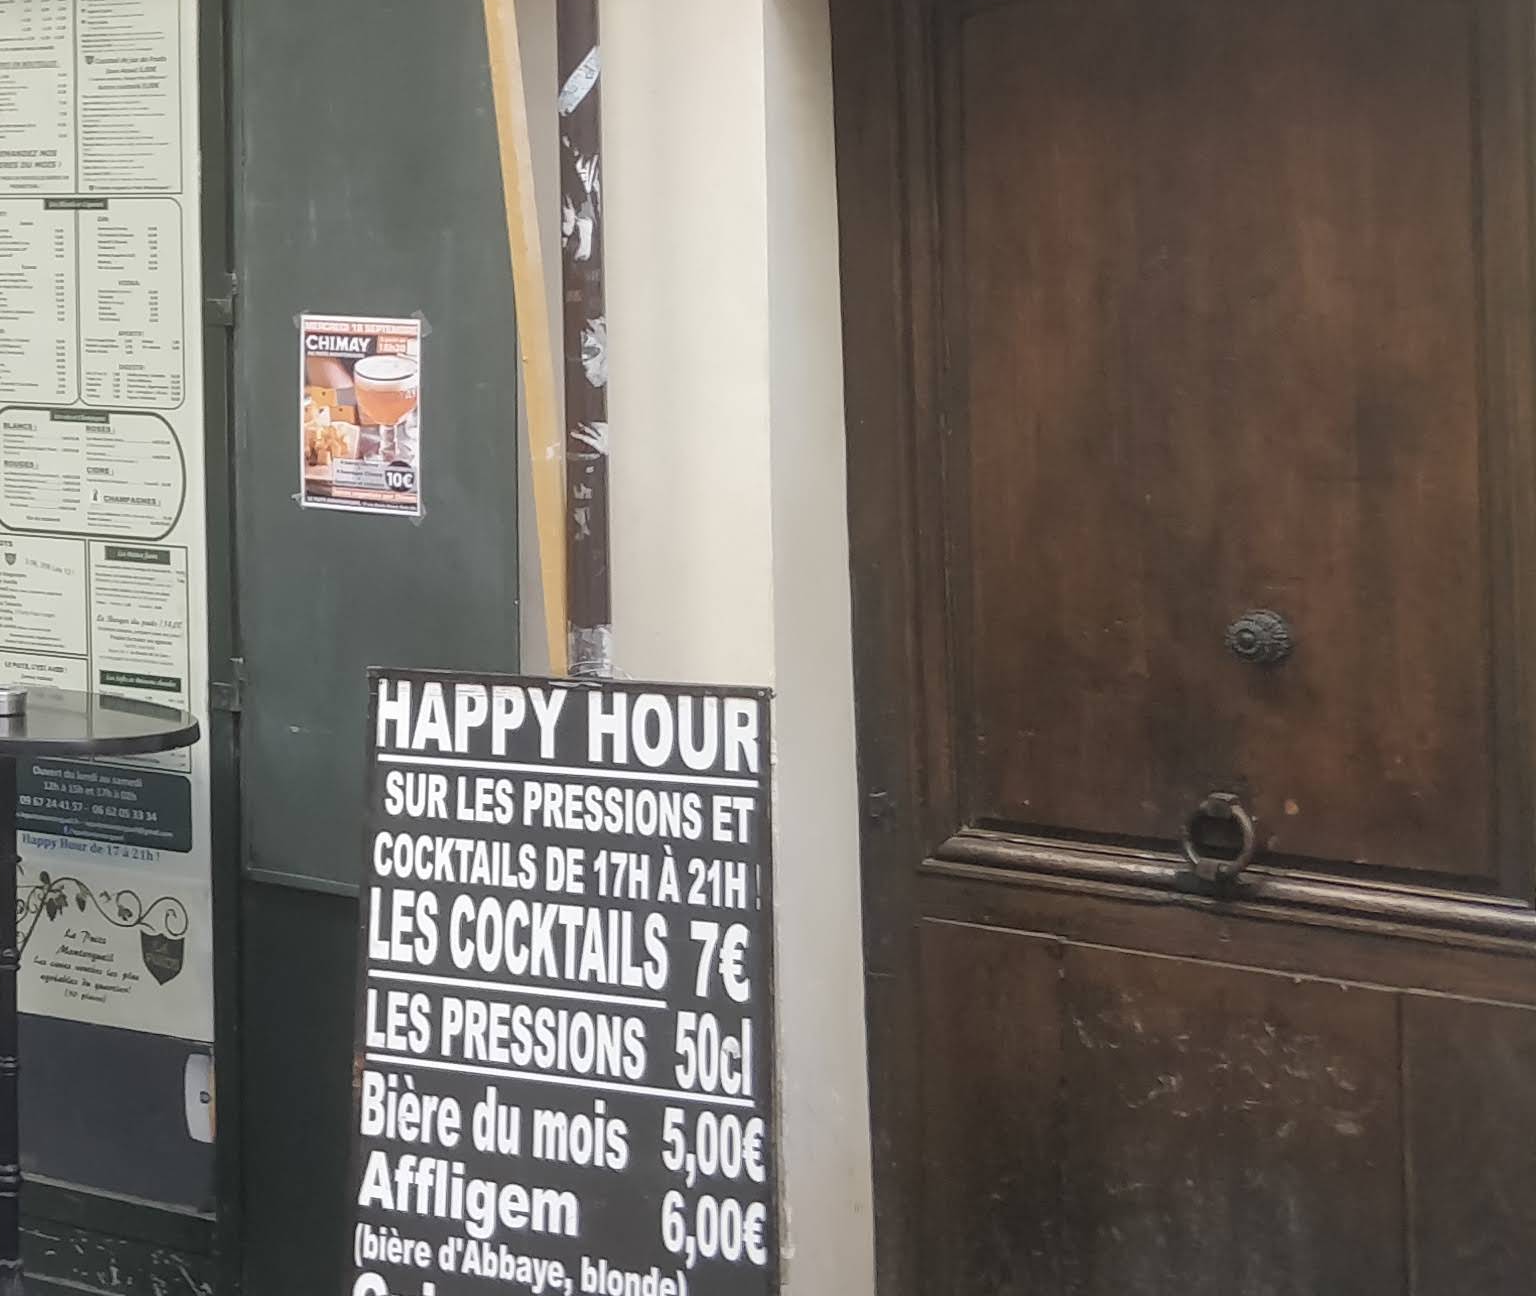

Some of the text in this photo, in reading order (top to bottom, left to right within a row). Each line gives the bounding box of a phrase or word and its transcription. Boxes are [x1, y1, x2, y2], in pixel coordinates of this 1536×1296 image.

[305, 334, 371, 353] CHIMAY
[386, 471, 414, 488] 10€
[375, 677, 760, 775] HAPPY HOUR
[21, 833, 58, 850] Happy
[384, 770, 756, 844] SUR LES PRESSIONS ET
[373, 831, 538, 891] COCKTAILS
[545, 845, 586, 895] DE
[593, 849, 650, 901] 17H
[656, 844, 681, 904] À
[687, 857, 747, 910] 21H
[368, 885, 751, 1003] LES COCKTAILS 7€
[365, 988, 754, 1097] LES PRESSIONS 50cl
[360, 1069, 767, 1189] Bière du mois 5,00€
[357, 1149, 769, 1270] Affligem 6,00€
[353, 1221, 432, 1268] (bière
[438, 1236, 574, 1295] d'Abbaye,
[579, 1254, 689, 1296] blonde)
